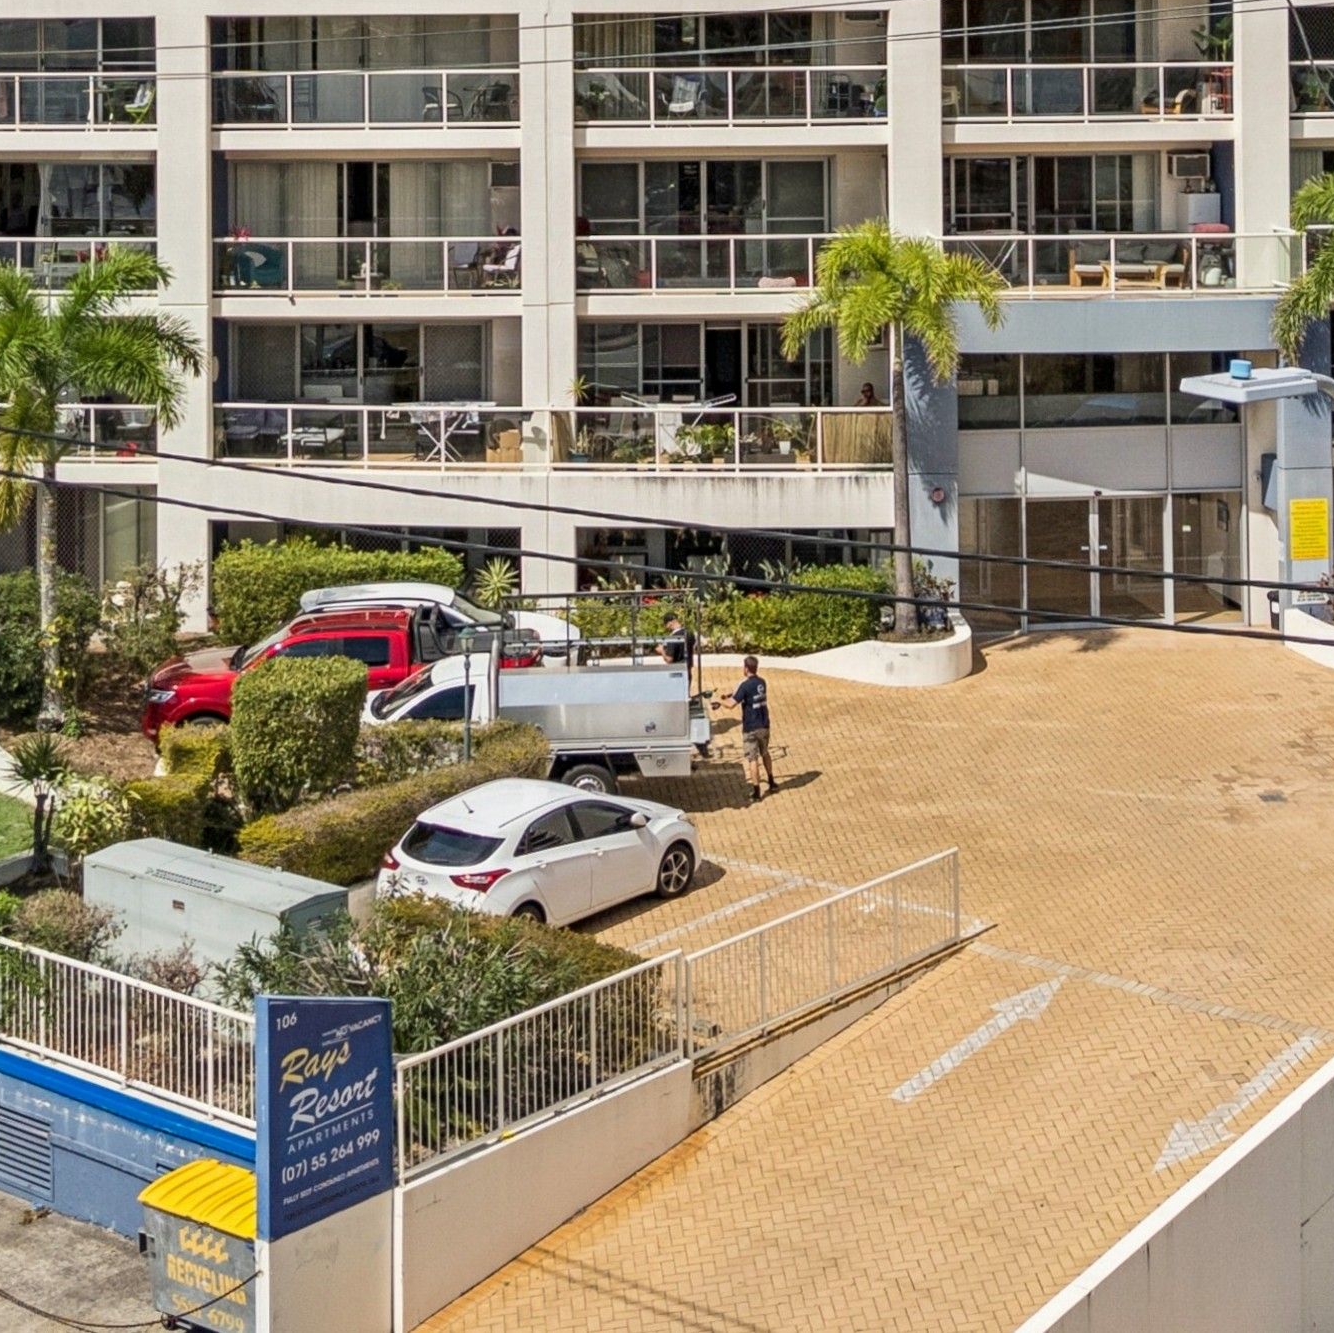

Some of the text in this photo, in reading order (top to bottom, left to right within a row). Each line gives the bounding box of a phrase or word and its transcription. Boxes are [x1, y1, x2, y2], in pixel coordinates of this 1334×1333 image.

[276, 1012, 298, 1031] 106
[279, 1041, 352, 1093] Rays
[289, 1067, 378, 1132] Resort
[282, 1128, 380, 1184] (07) 55 264 999
[288, 1108, 374, 1155] APARTMENTS
[166, 1252, 247, 1306] RECYCLING
